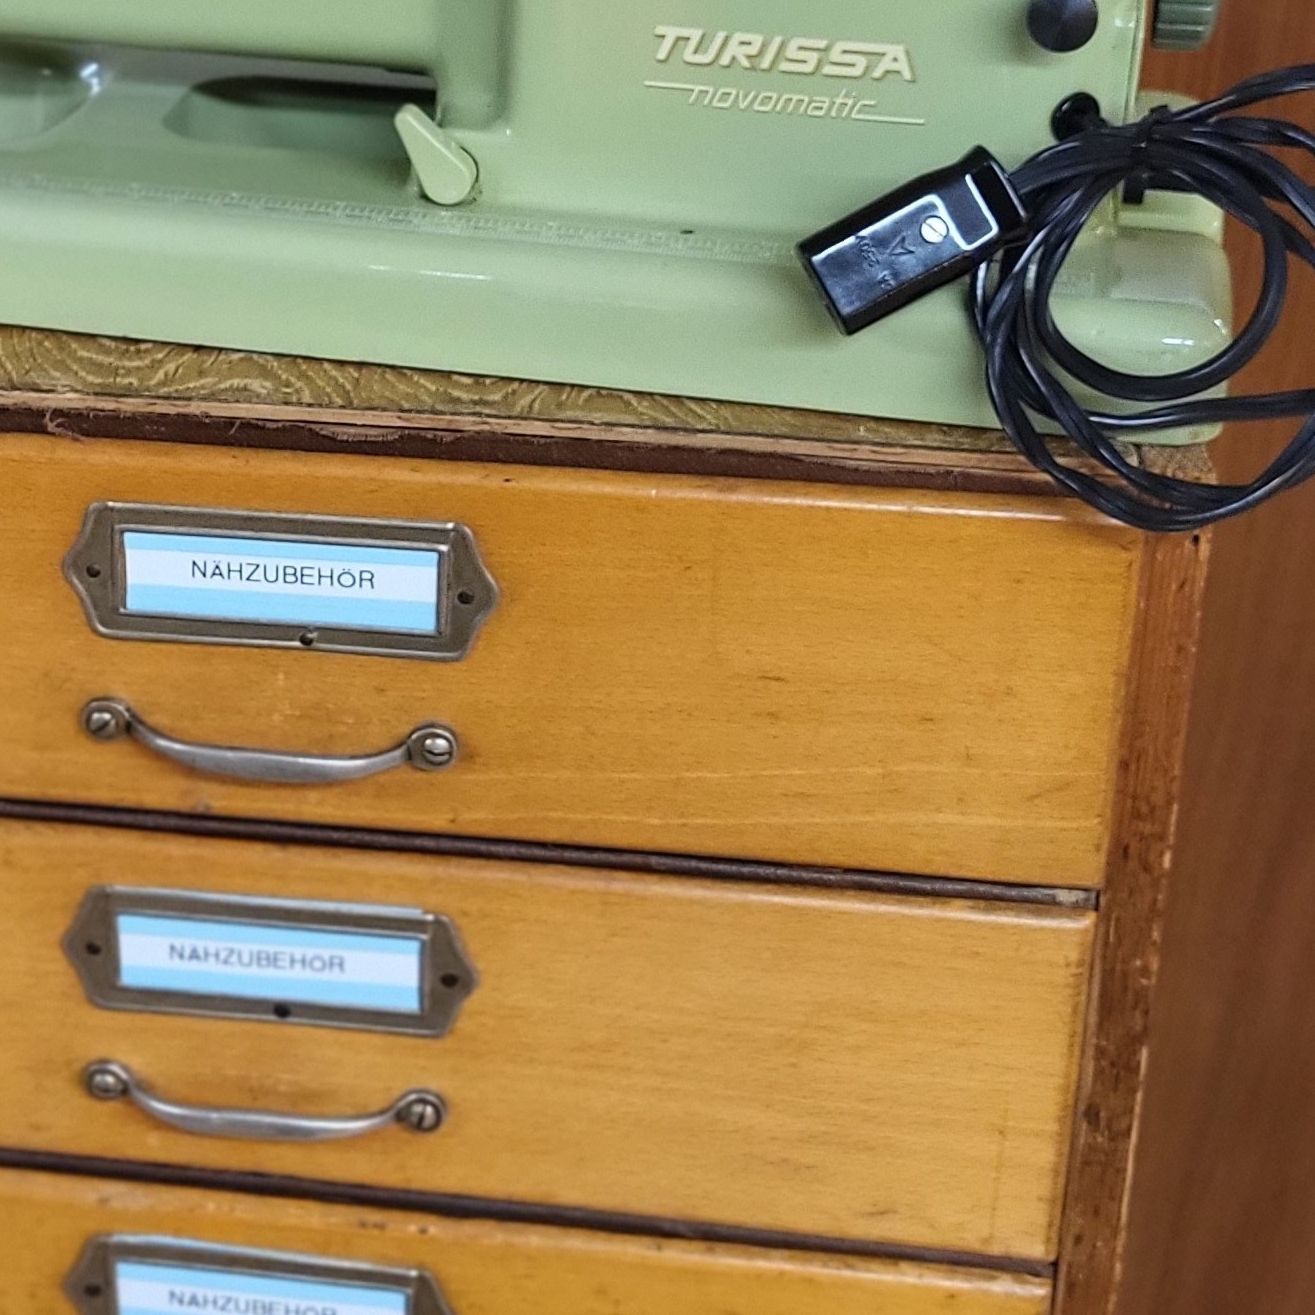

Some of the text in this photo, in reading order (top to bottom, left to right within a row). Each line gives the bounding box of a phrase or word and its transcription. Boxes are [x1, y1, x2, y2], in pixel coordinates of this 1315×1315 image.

[654, 25, 916, 82] TURISSA
[688, 88, 877, 119] novomatic
[191, 559, 376, 590] NÄHZUBEHÖR
